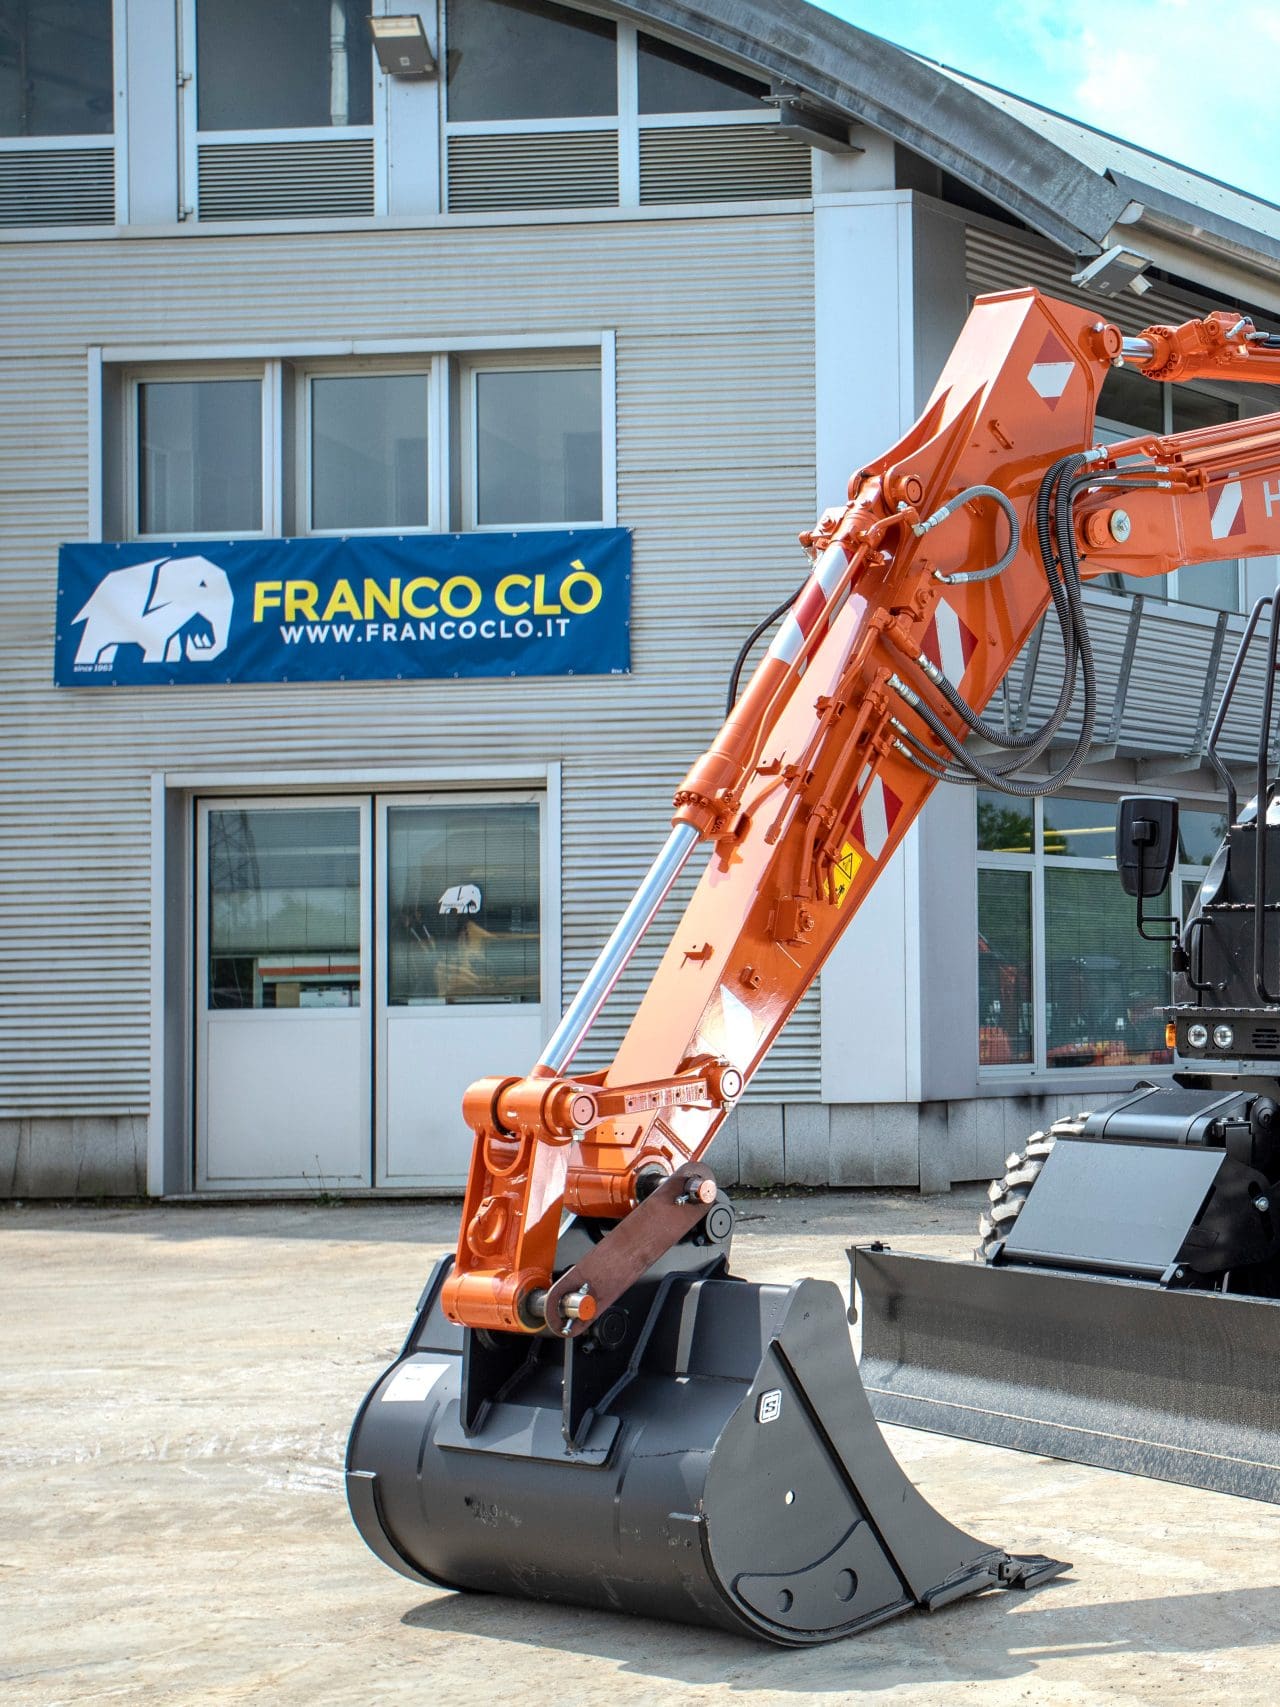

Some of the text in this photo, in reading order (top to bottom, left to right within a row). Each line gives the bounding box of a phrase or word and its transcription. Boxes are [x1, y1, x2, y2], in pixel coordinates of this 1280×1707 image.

[253, 559, 602, 622] FRANCO CLÒ
[279, 618, 572, 644] WWW.FRANCOCLO.IT
